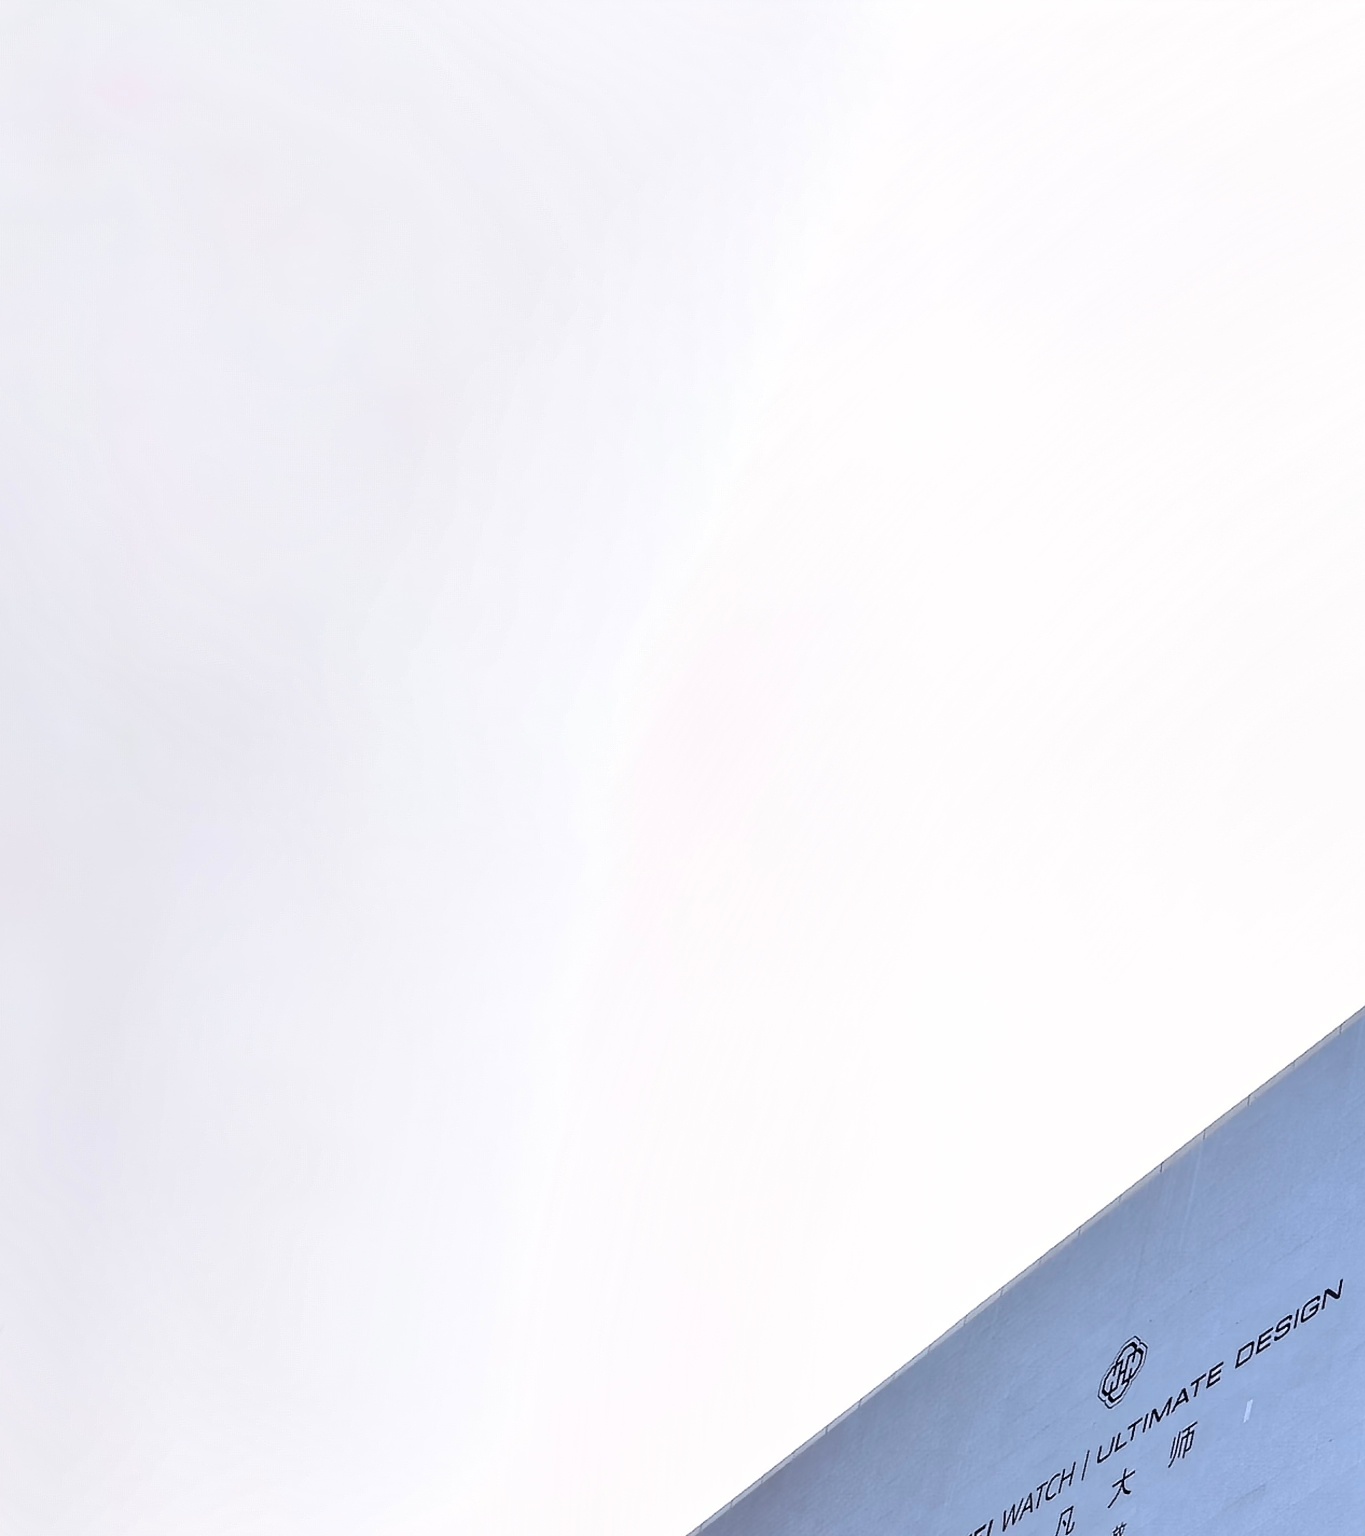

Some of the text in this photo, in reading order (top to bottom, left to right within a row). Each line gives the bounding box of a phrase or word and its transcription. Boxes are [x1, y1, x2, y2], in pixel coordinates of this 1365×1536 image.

[1002, 1462, 1077, 1532] WATCH
[1097, 1362, 1224, 1464] ULTIMATE
[1235, 1279, 1344, 1369] DESIGN
